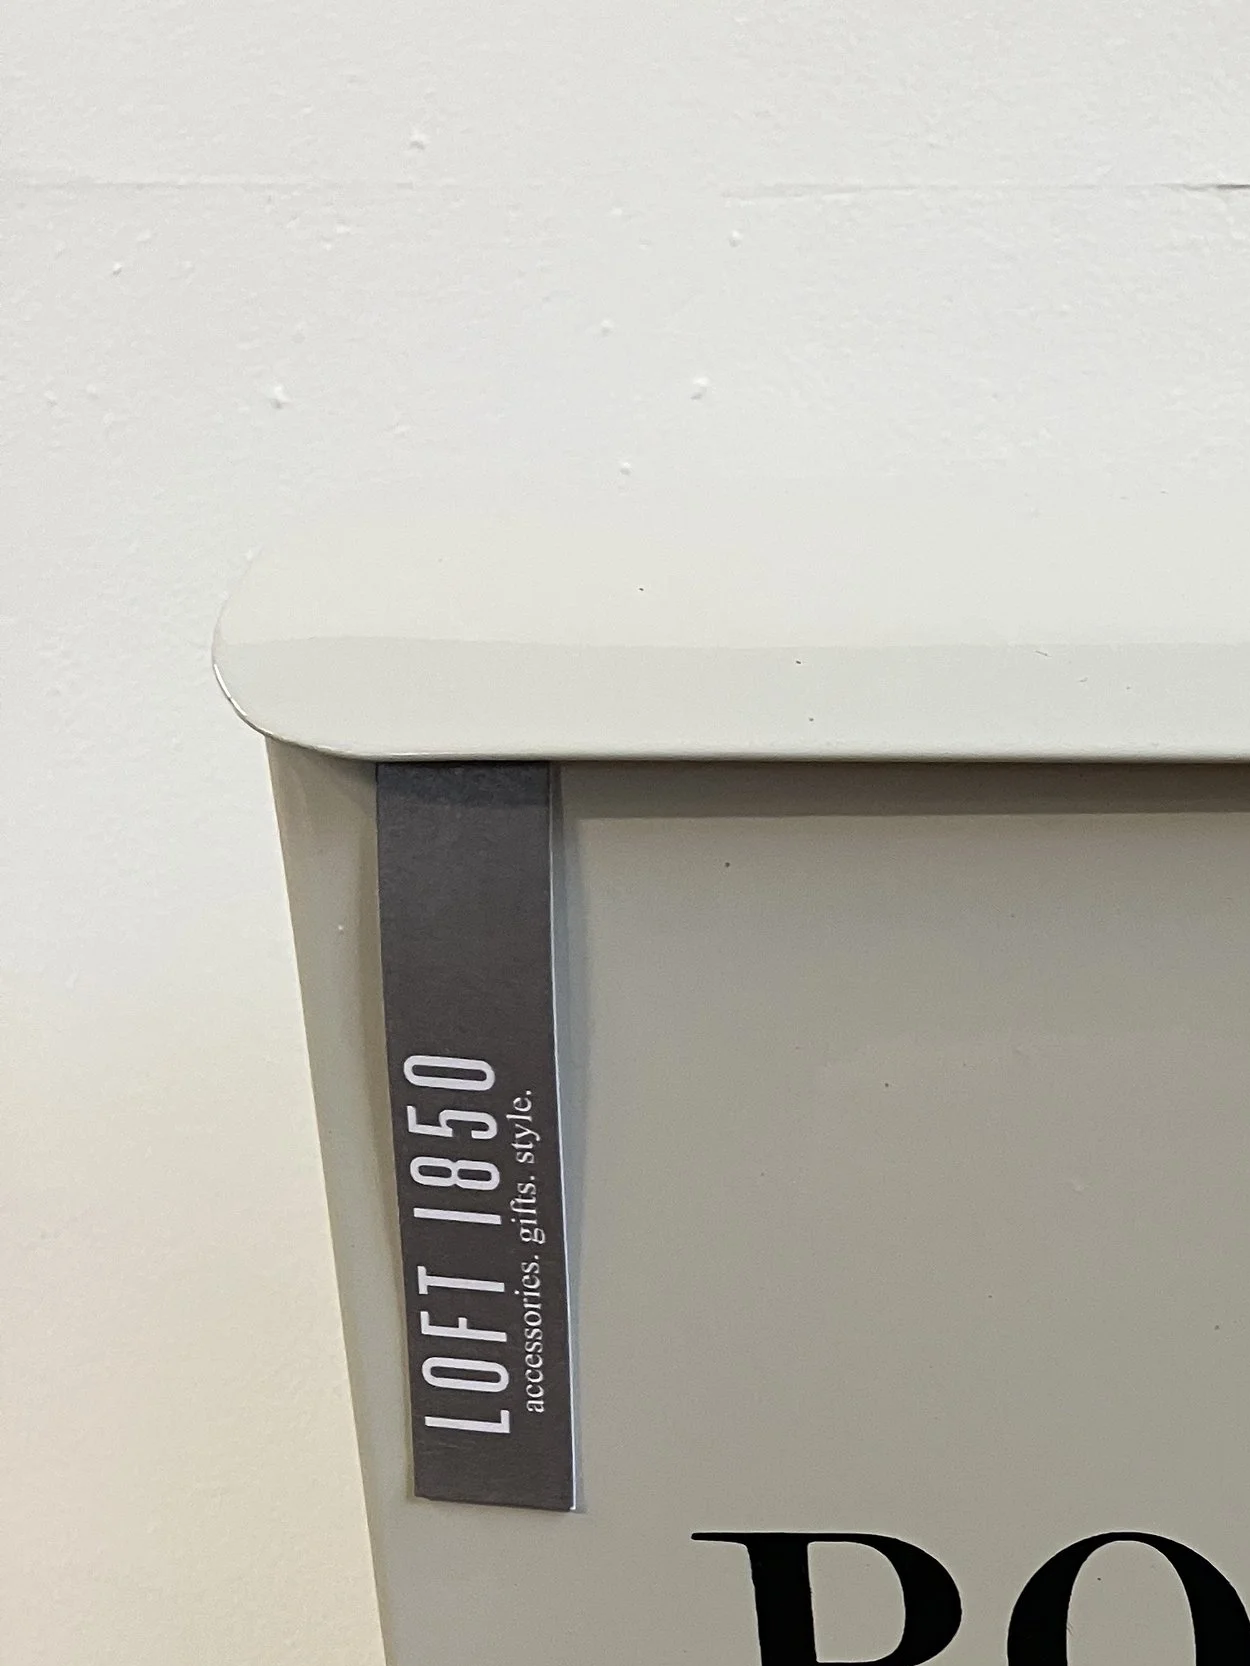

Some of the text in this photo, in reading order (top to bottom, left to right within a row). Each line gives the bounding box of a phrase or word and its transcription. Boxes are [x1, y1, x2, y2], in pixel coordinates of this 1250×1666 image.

[403, 1054, 511, 1434] LOFT 1850
[505, 1089, 546, 1414] accessories. gifts. style.
